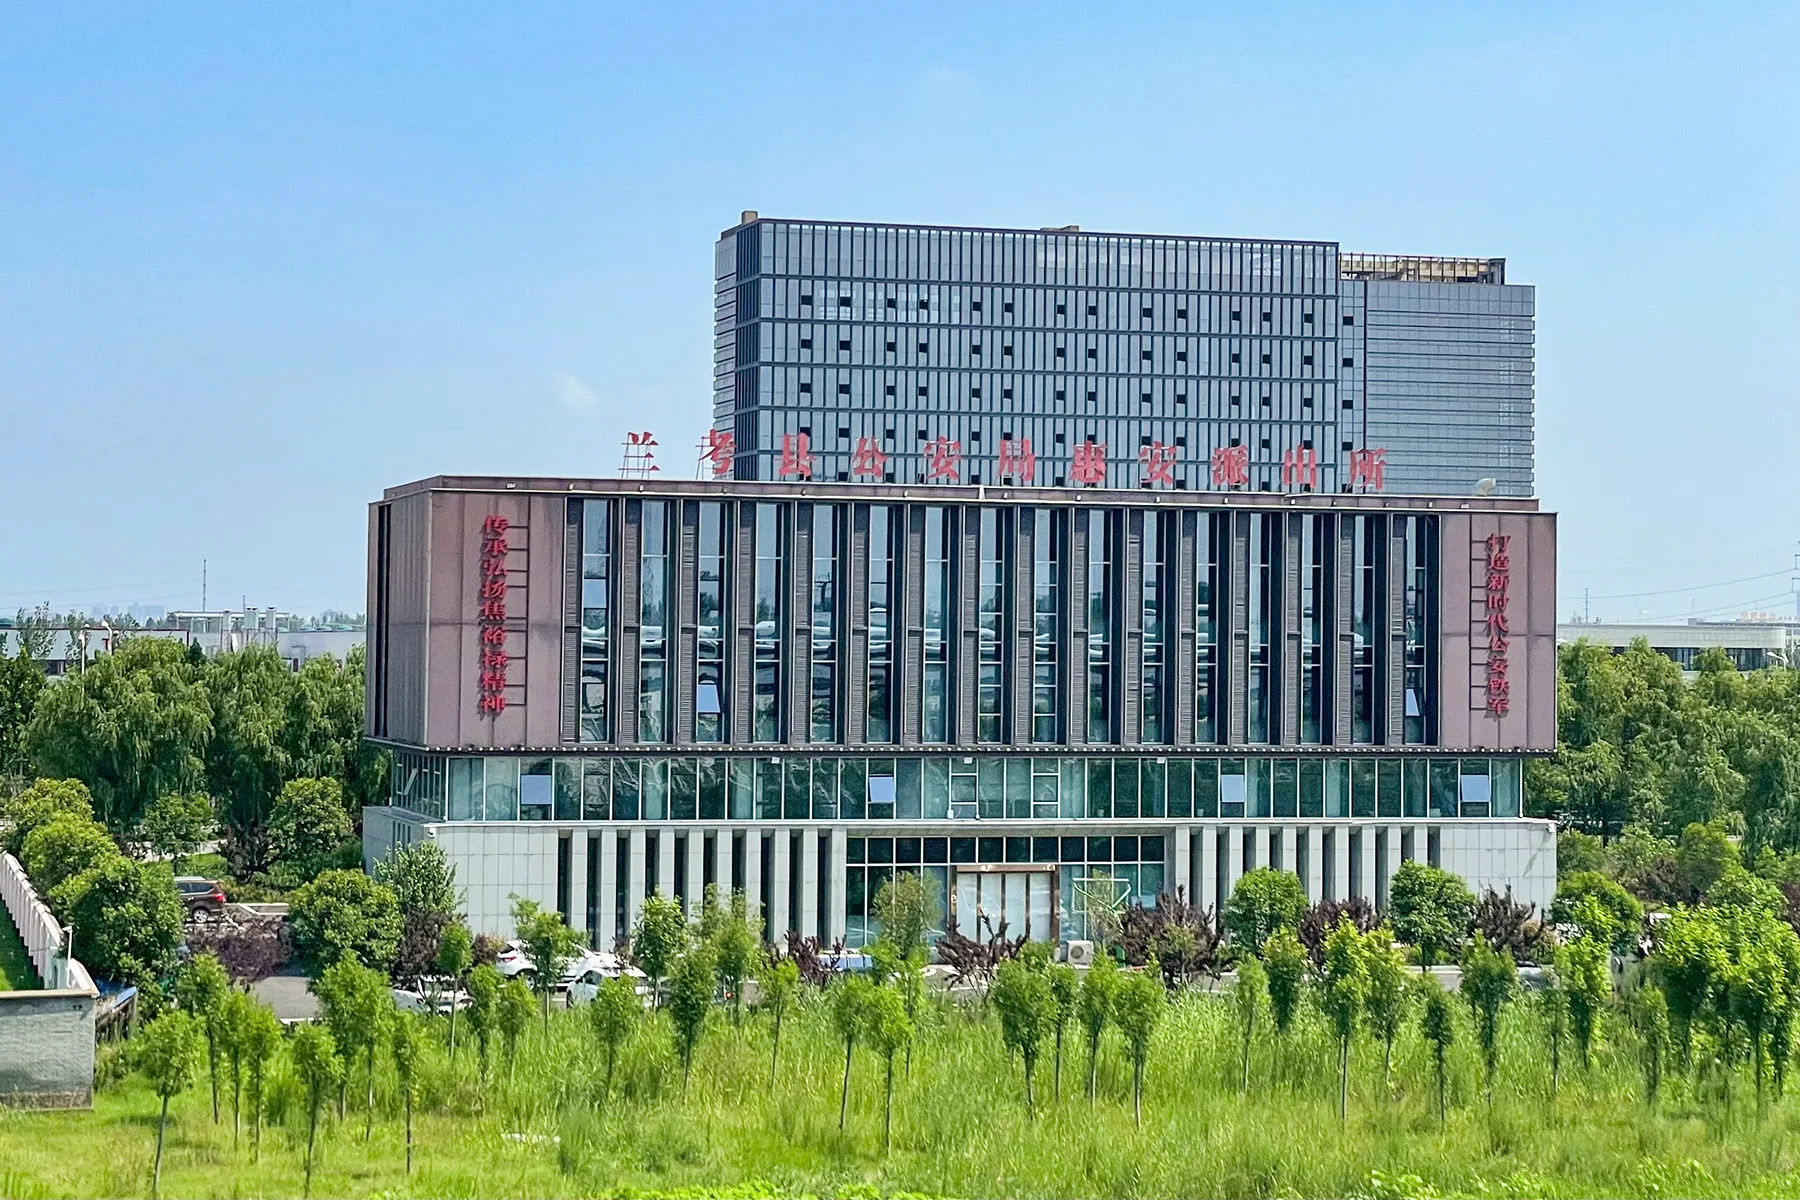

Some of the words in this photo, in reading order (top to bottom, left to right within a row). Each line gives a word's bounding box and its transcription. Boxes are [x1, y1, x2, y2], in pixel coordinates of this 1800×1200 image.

[481, 515, 509, 714] 传承弘扬焦裕禄精神
[1487, 533, 1511, 715] 打造新时代公安铁军
